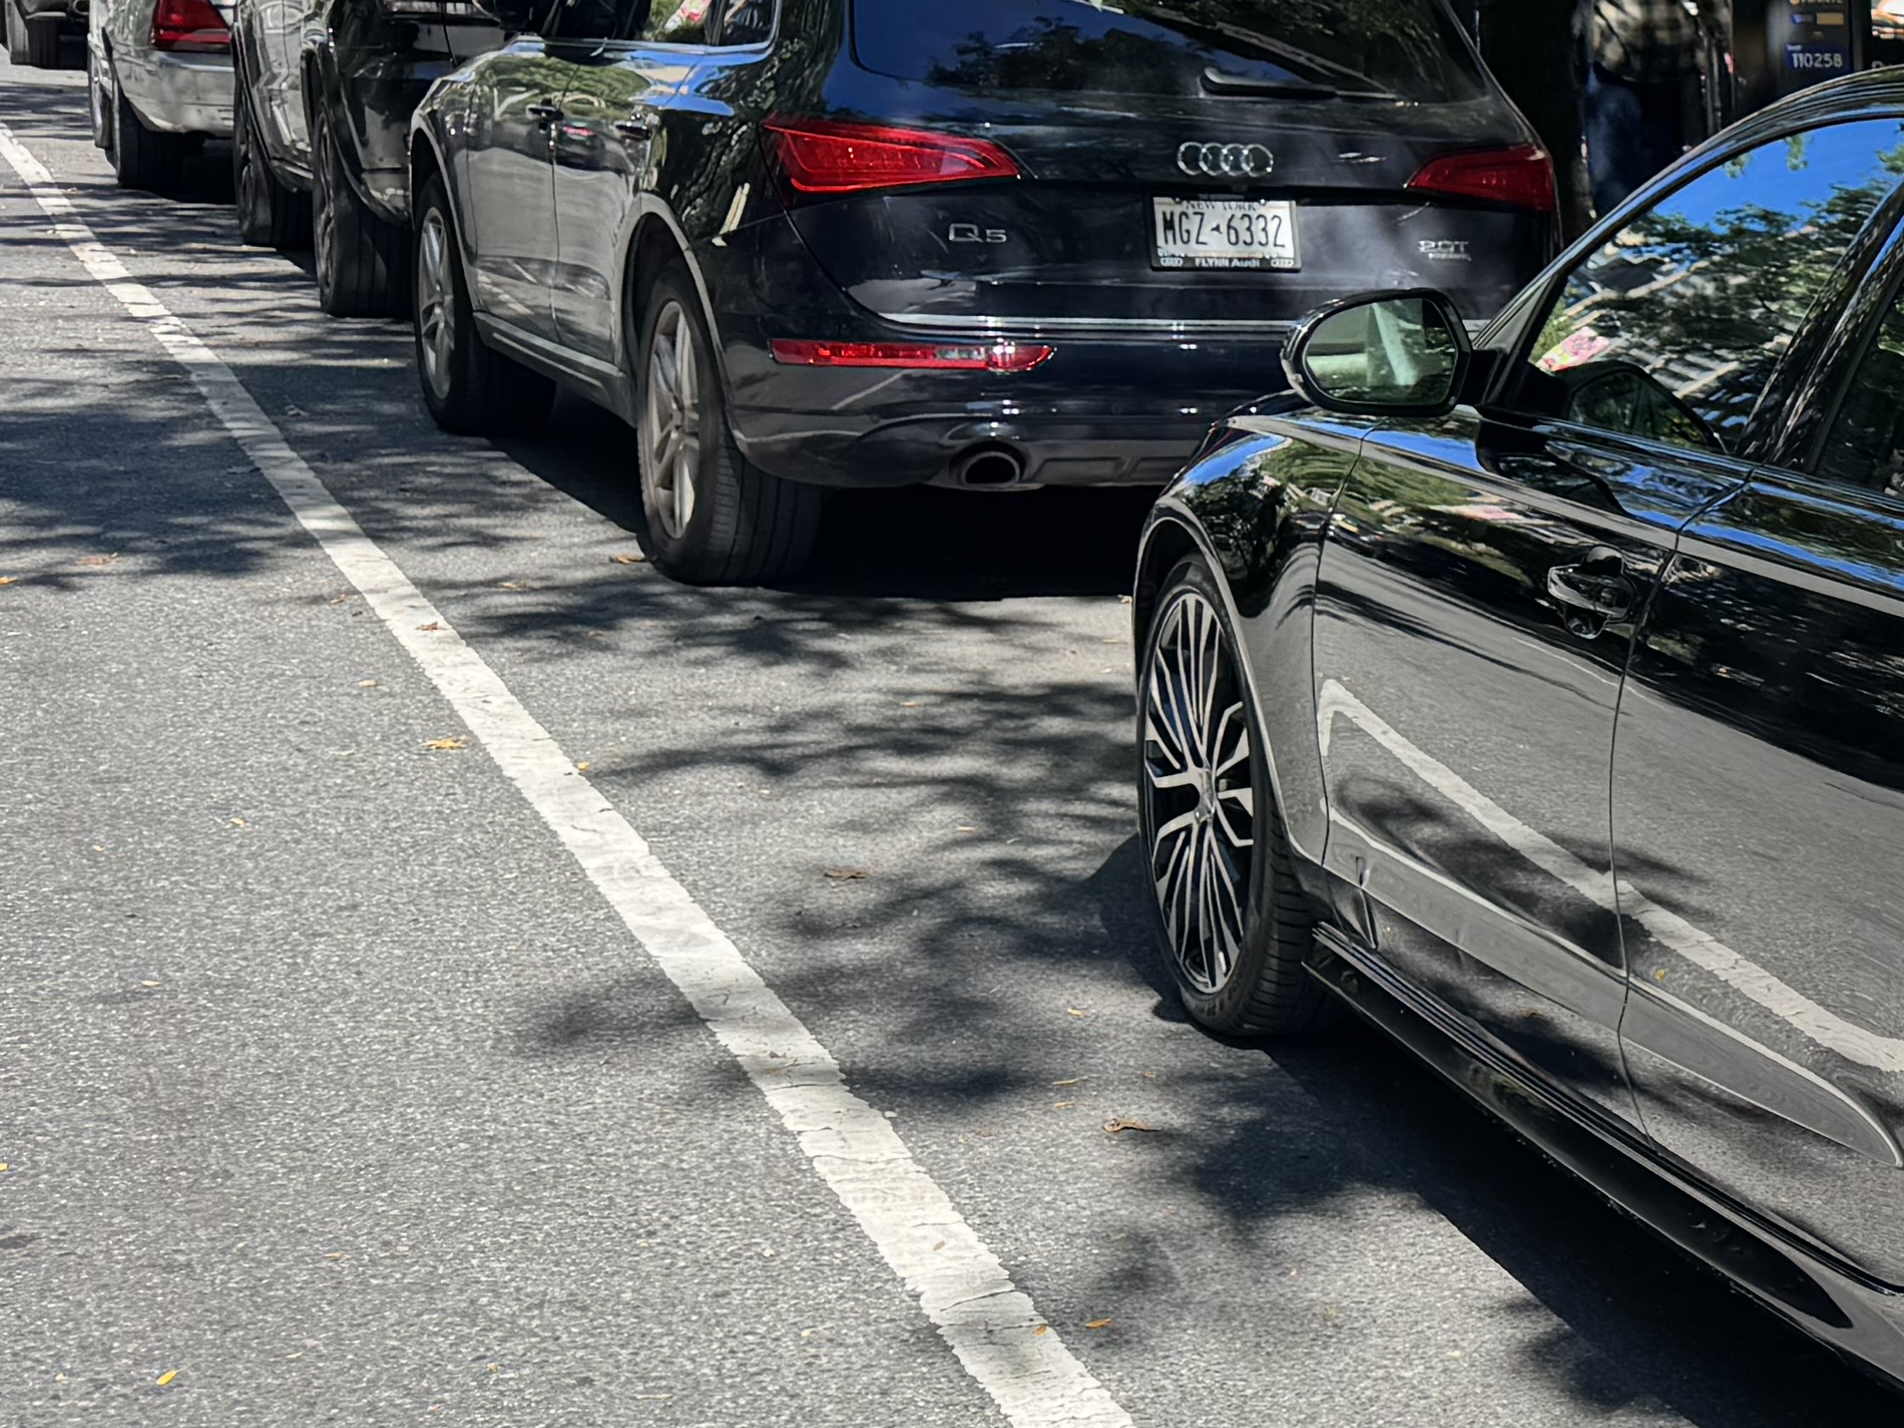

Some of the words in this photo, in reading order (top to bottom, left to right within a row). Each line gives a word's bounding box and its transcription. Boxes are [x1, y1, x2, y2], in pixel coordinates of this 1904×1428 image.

[1792, 53, 1844, 69] 110258
[948, 223, 1007, 243] Q5
[1226, 213, 1286, 248] 6332
